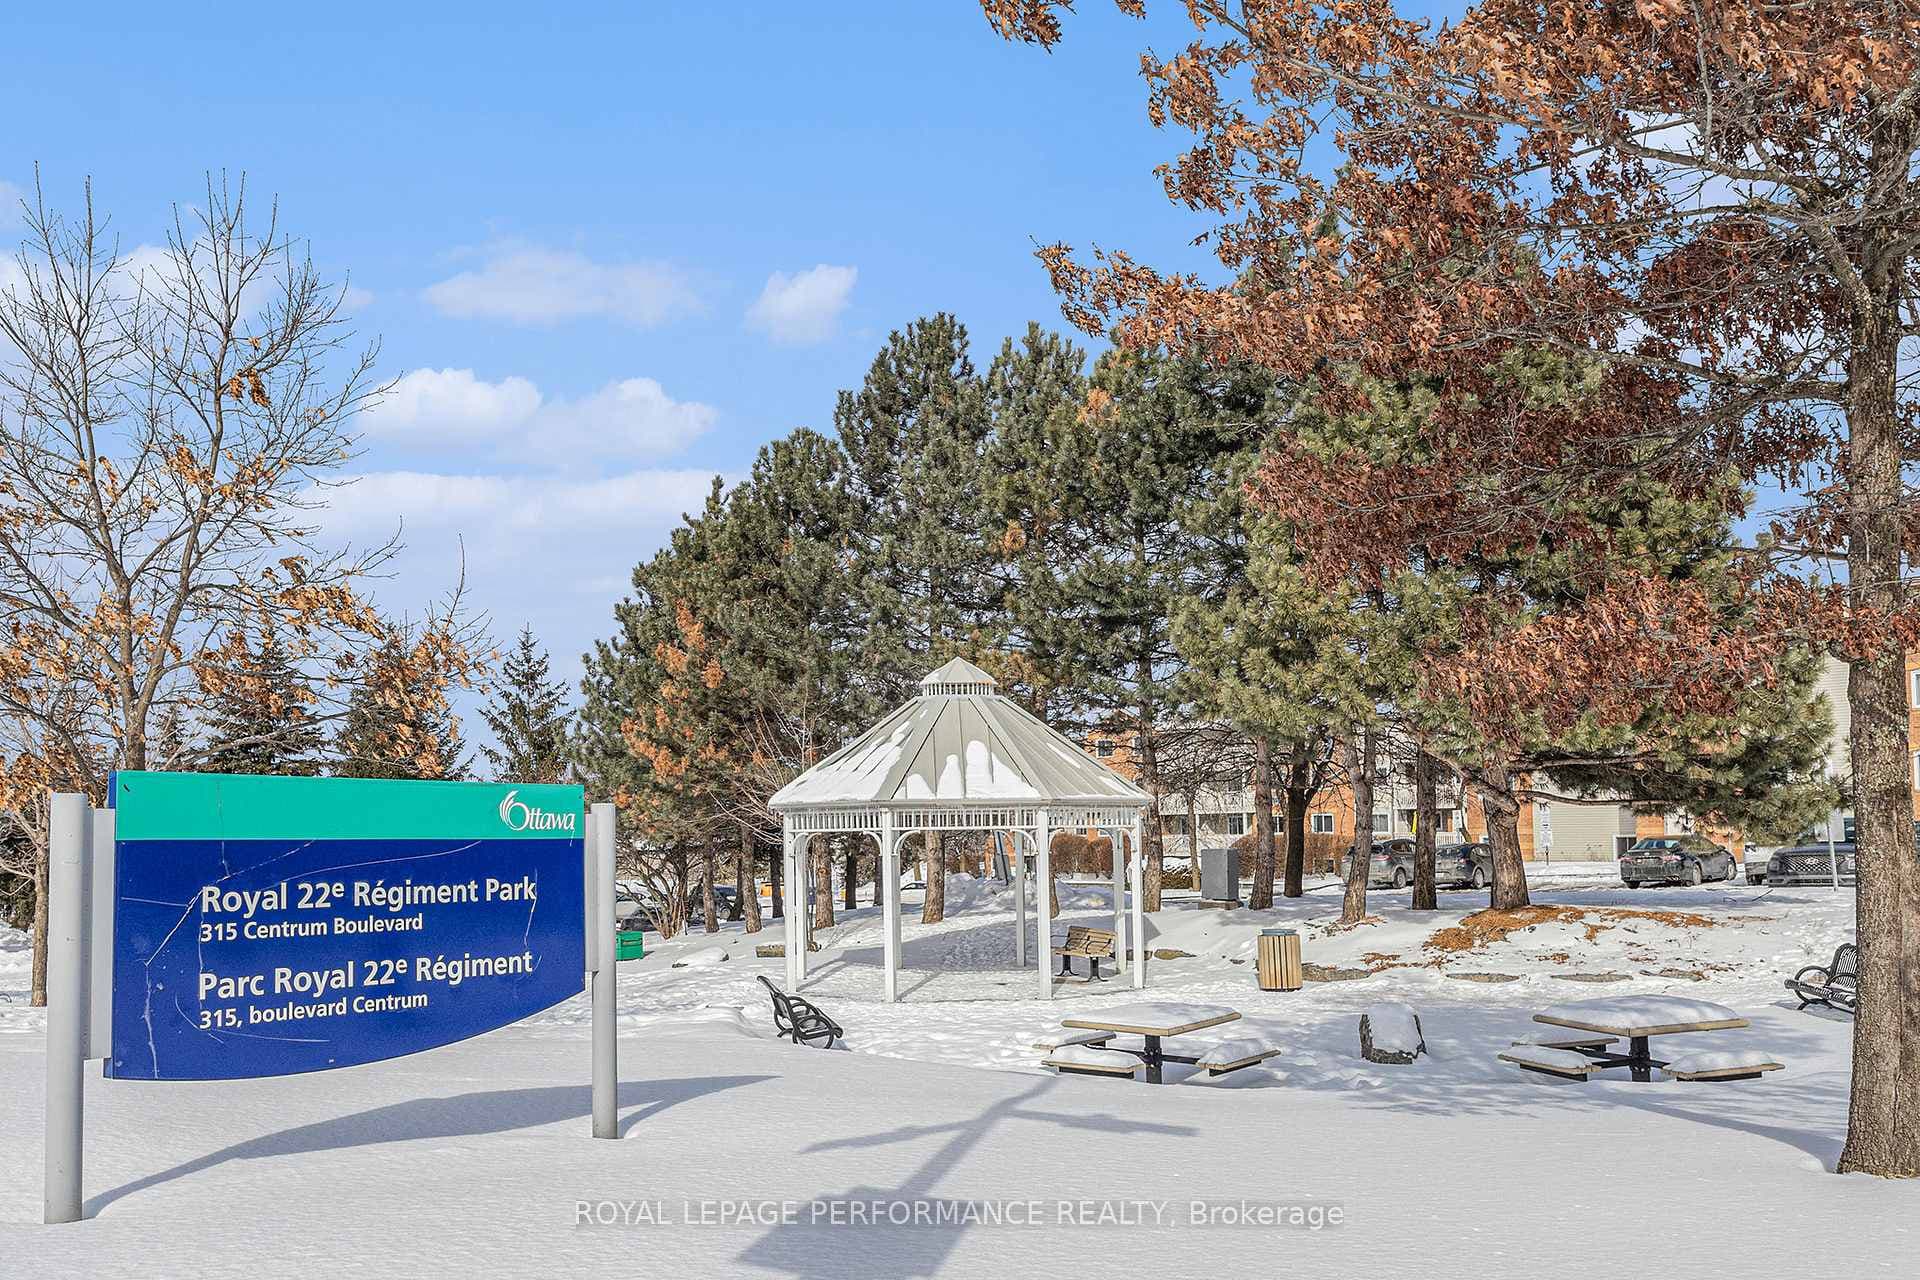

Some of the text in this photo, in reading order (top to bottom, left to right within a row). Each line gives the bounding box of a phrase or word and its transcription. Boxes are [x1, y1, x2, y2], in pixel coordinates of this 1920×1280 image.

[500, 791, 576, 831] Ottawa
[202, 876, 537, 919] Royal 22e Régiment Park
[201, 913, 423, 942] 315 Centrum Boulevard
[200, 951, 533, 1000] Parc Royal 22e Régiment
[200, 994, 428, 1029] 315, boulevard Centrum
